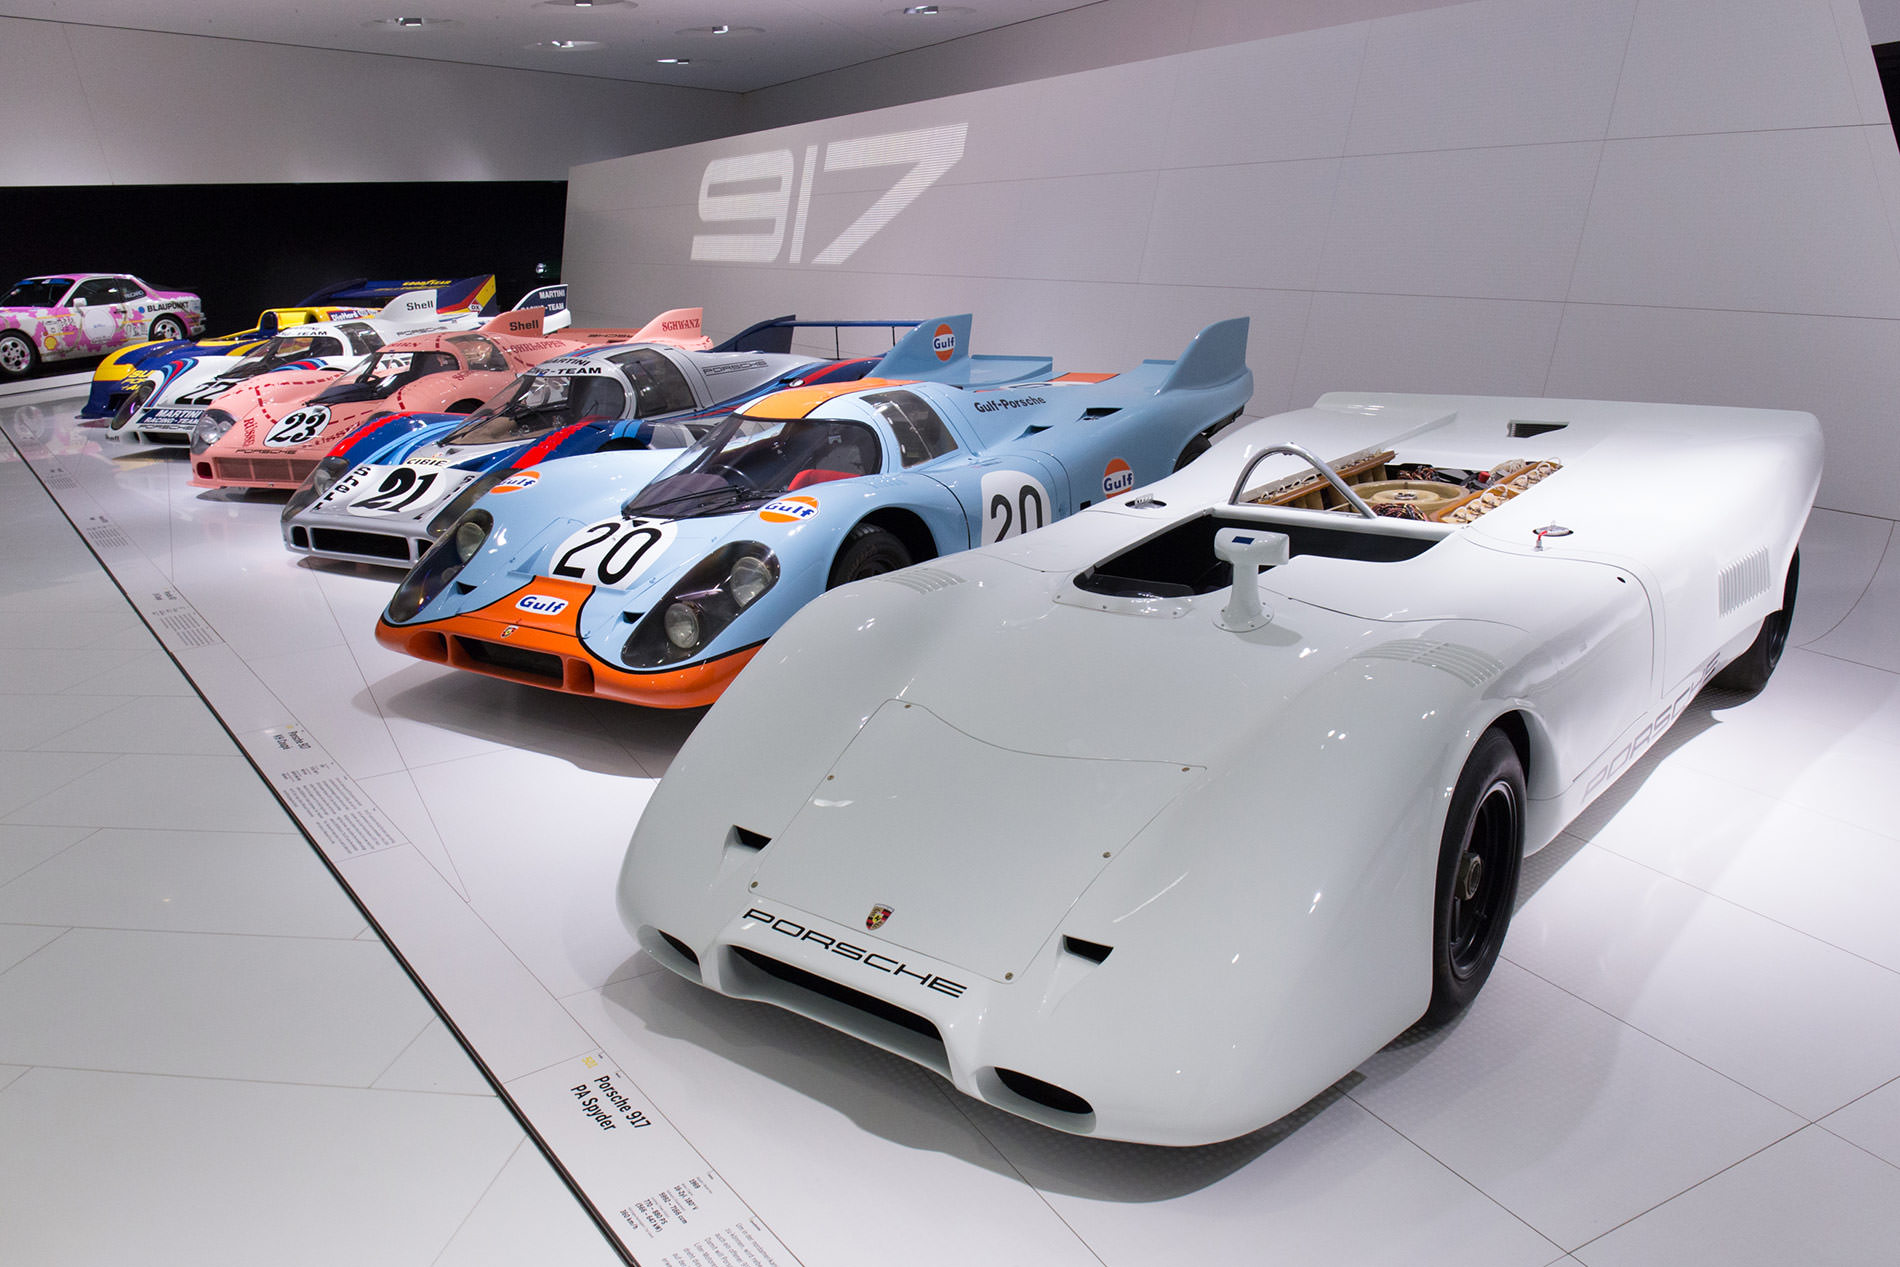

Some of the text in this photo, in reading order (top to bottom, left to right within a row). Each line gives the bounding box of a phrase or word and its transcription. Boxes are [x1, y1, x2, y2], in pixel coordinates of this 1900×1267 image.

[690, 122, 969, 265] 917
[539, 289, 566, 299] MARTINI
[147, 301, 189, 312] BLAUPUNKT
[406, 301, 434, 311] Shell
[509, 320, 539, 332] Shell
[662, 318, 700, 332] SCHWANZ
[933, 336, 956, 351] Gulf
[702, 360, 768, 375] PORSCHE
[974, 396, 1047, 413] Gulf-Porsche
[156, 409, 203, 418] MARTINI
[267, 412, 327, 443] 23
[406, 458, 448, 467] CIBIE
[350, 467, 439, 513] 21
[500, 478, 537, 487] Gulf
[1104, 472, 1133, 493] Gulf
[764, 501, 815, 519] Gulf
[991, 484, 1043, 544] 20
[552, 522, 663, 586] 20
[519, 594, 566, 614] Gulf
[743, 908, 968, 999] PORSCHE
[570, 1084, 592, 1100] PA
[582, 1097, 617, 1131] Spyder
[594, 1075, 651, 1129] Porsche 917
